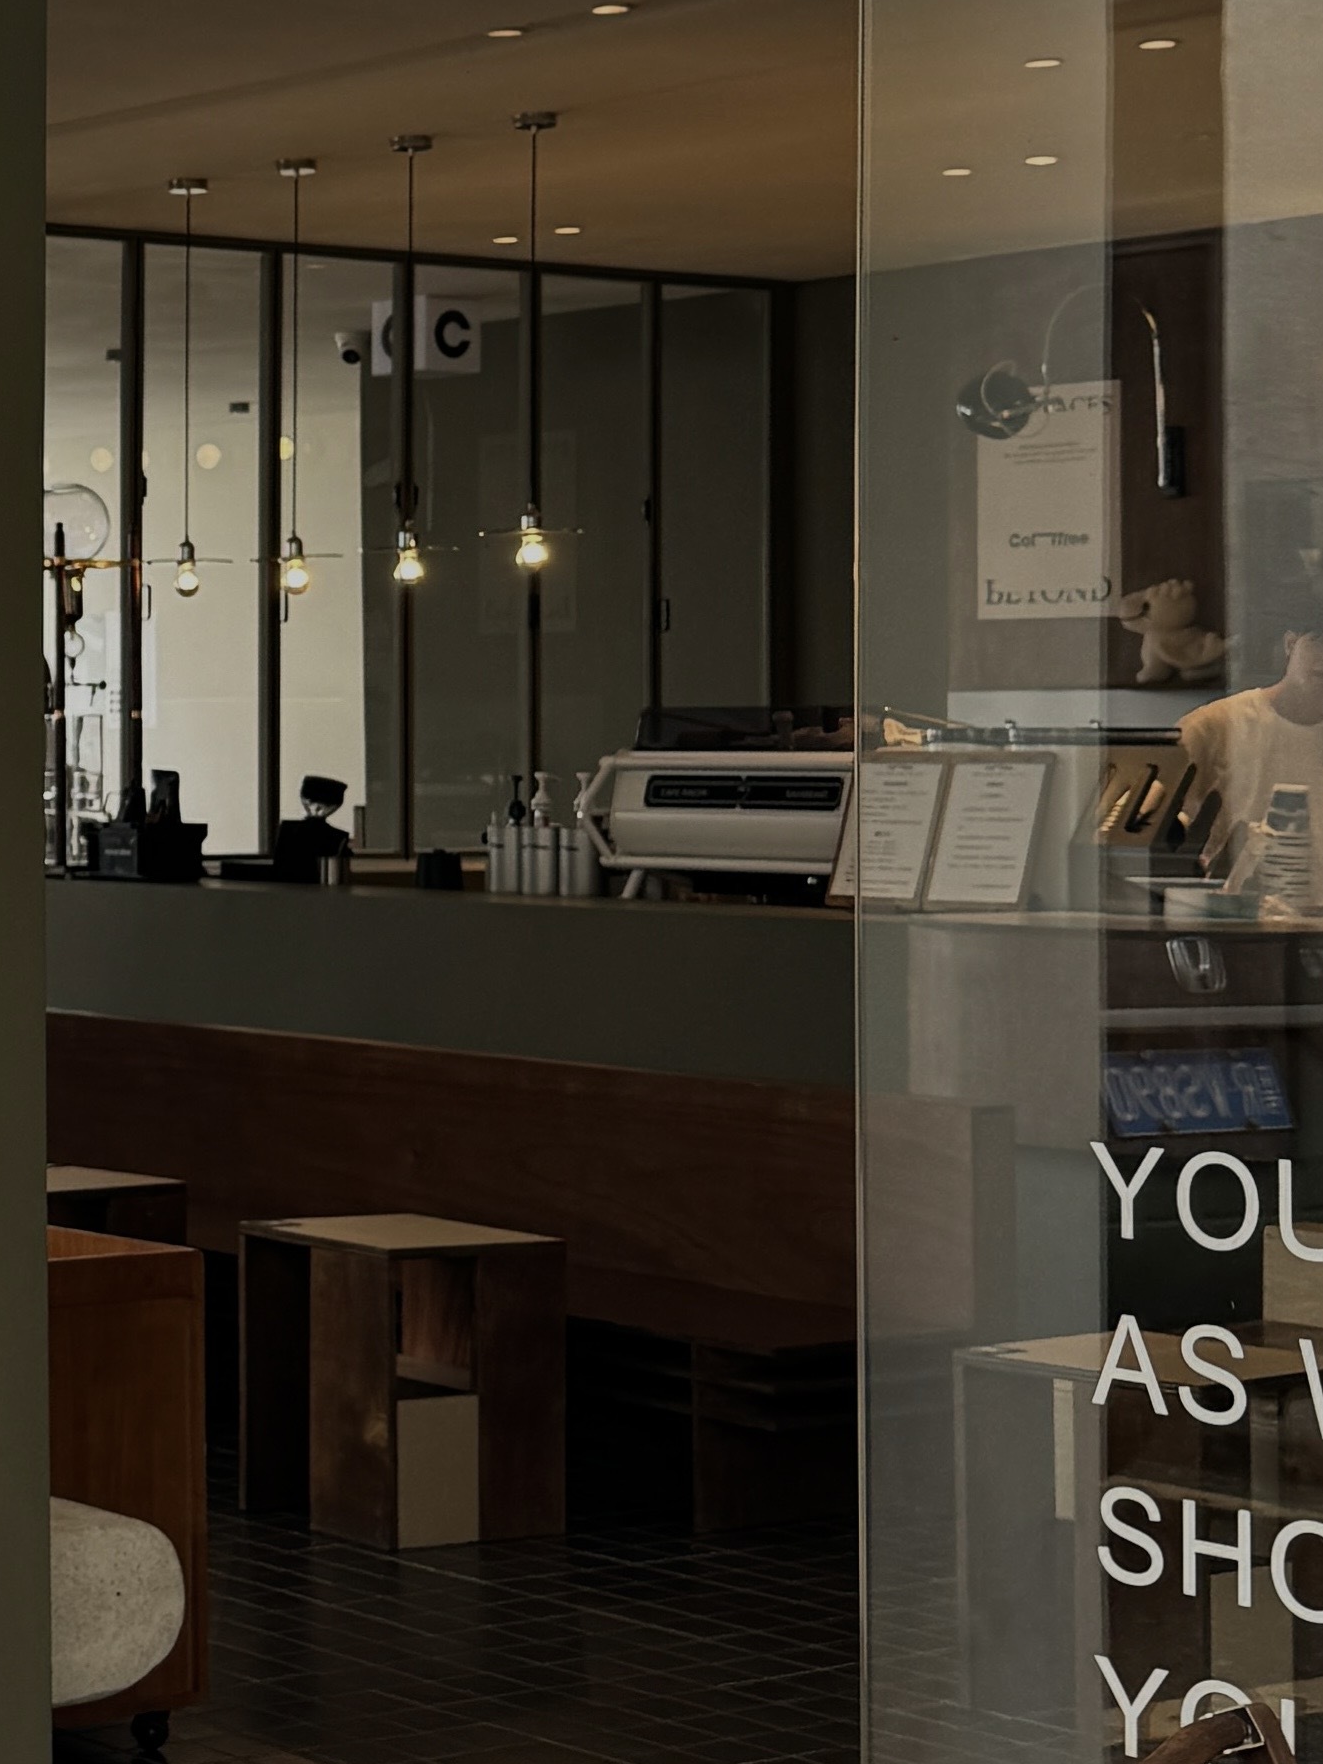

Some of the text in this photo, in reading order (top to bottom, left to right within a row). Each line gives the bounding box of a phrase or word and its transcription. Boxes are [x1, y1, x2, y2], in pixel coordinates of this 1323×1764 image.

[434, 309, 471, 358] C
[1090, 1141, 1323, 1262] YOU
[1092, 1314, 1247, 1425] AS
[1098, 1486, 1323, 1624] SHO
